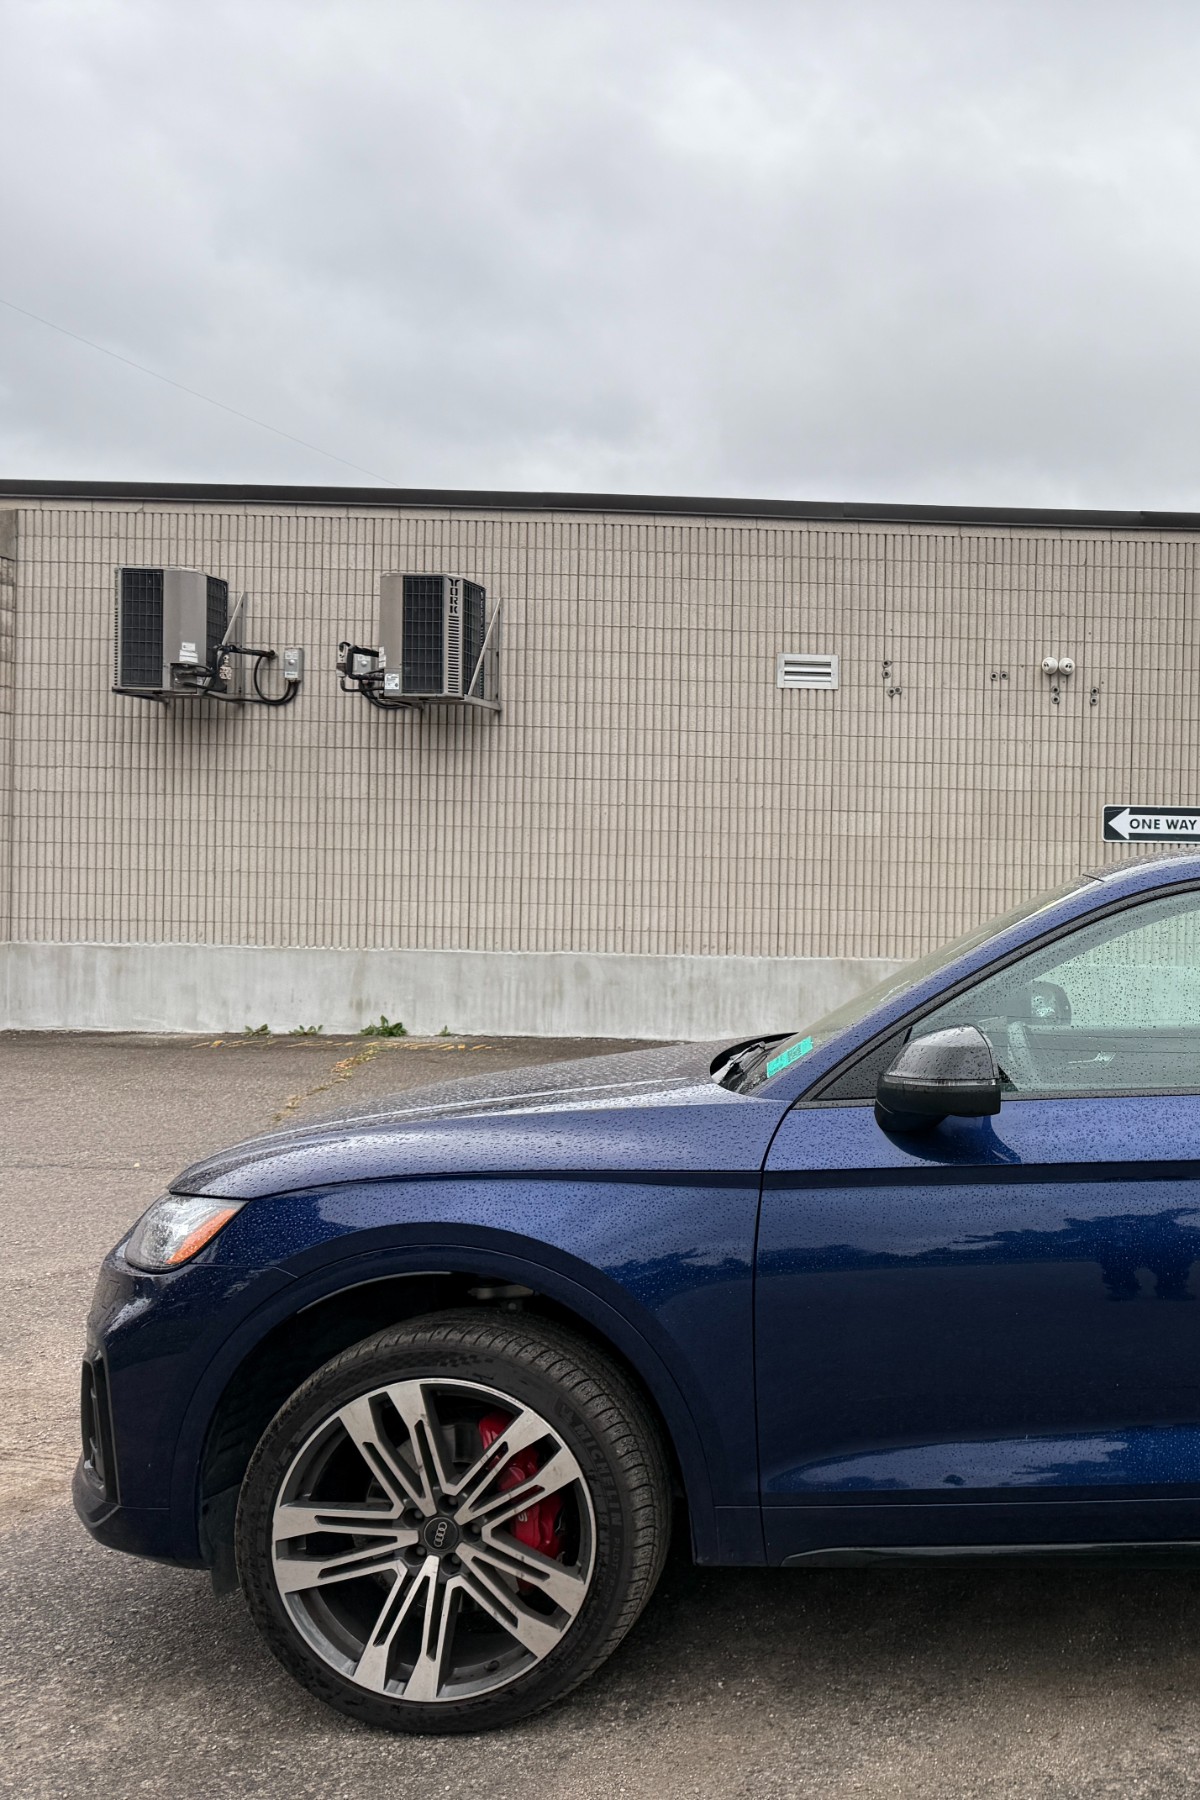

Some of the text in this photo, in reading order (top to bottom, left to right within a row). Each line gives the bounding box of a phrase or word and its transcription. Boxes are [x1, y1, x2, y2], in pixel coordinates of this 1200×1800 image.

[447, 577, 460, 614] YORK
[1129, 818, 1197, 830] ONE WAY
[574, 1422, 622, 1526] MICHELIN
